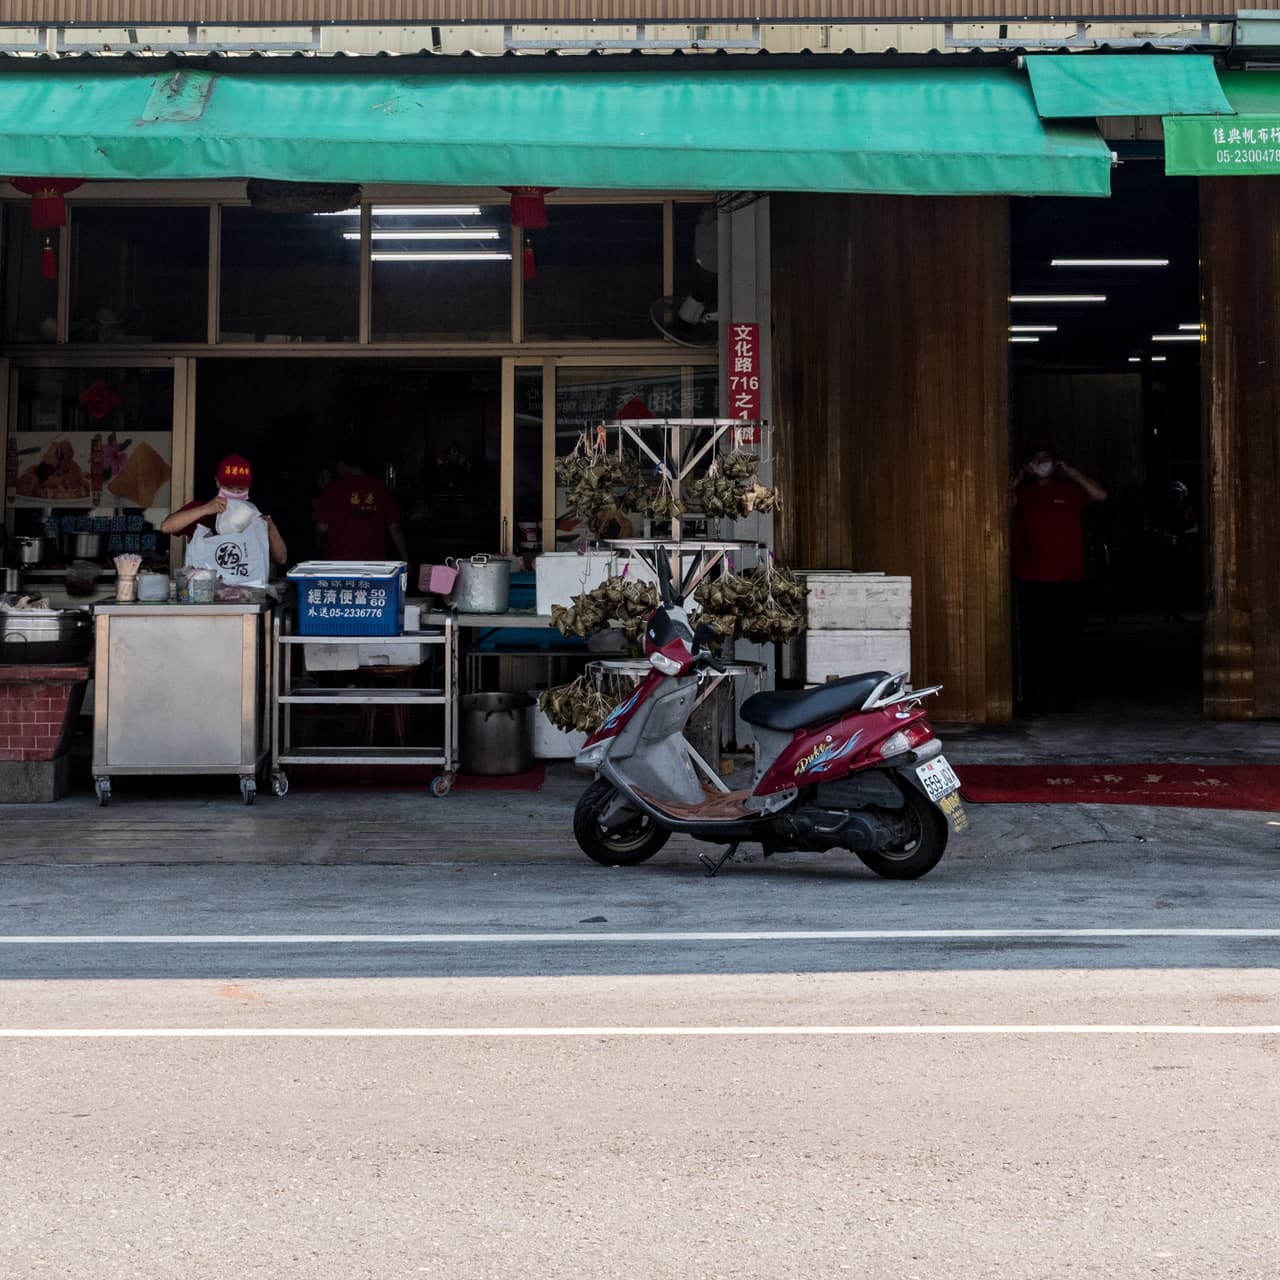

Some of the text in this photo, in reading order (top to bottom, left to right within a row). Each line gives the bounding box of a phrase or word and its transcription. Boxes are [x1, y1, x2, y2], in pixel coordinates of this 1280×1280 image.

[307, 588, 386, 605] 經濟便當 50
[369, 599, 386, 607] 60
